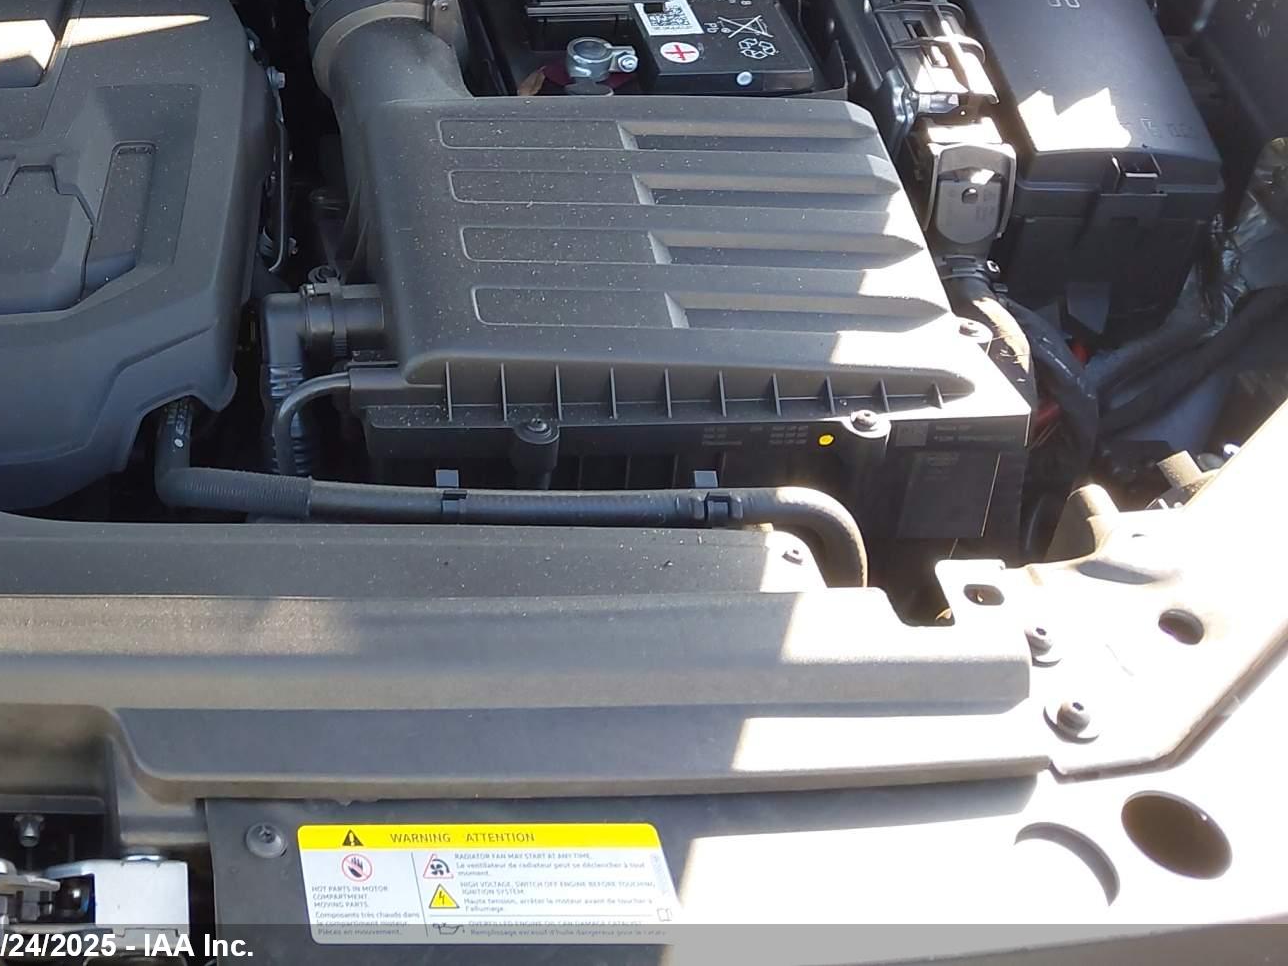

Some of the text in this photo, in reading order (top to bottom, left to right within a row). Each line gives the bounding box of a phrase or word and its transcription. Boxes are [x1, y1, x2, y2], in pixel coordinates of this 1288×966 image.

[704, 22, 719, 33] Pb
[390, 833, 535, 843] WARNING ATTENTION
